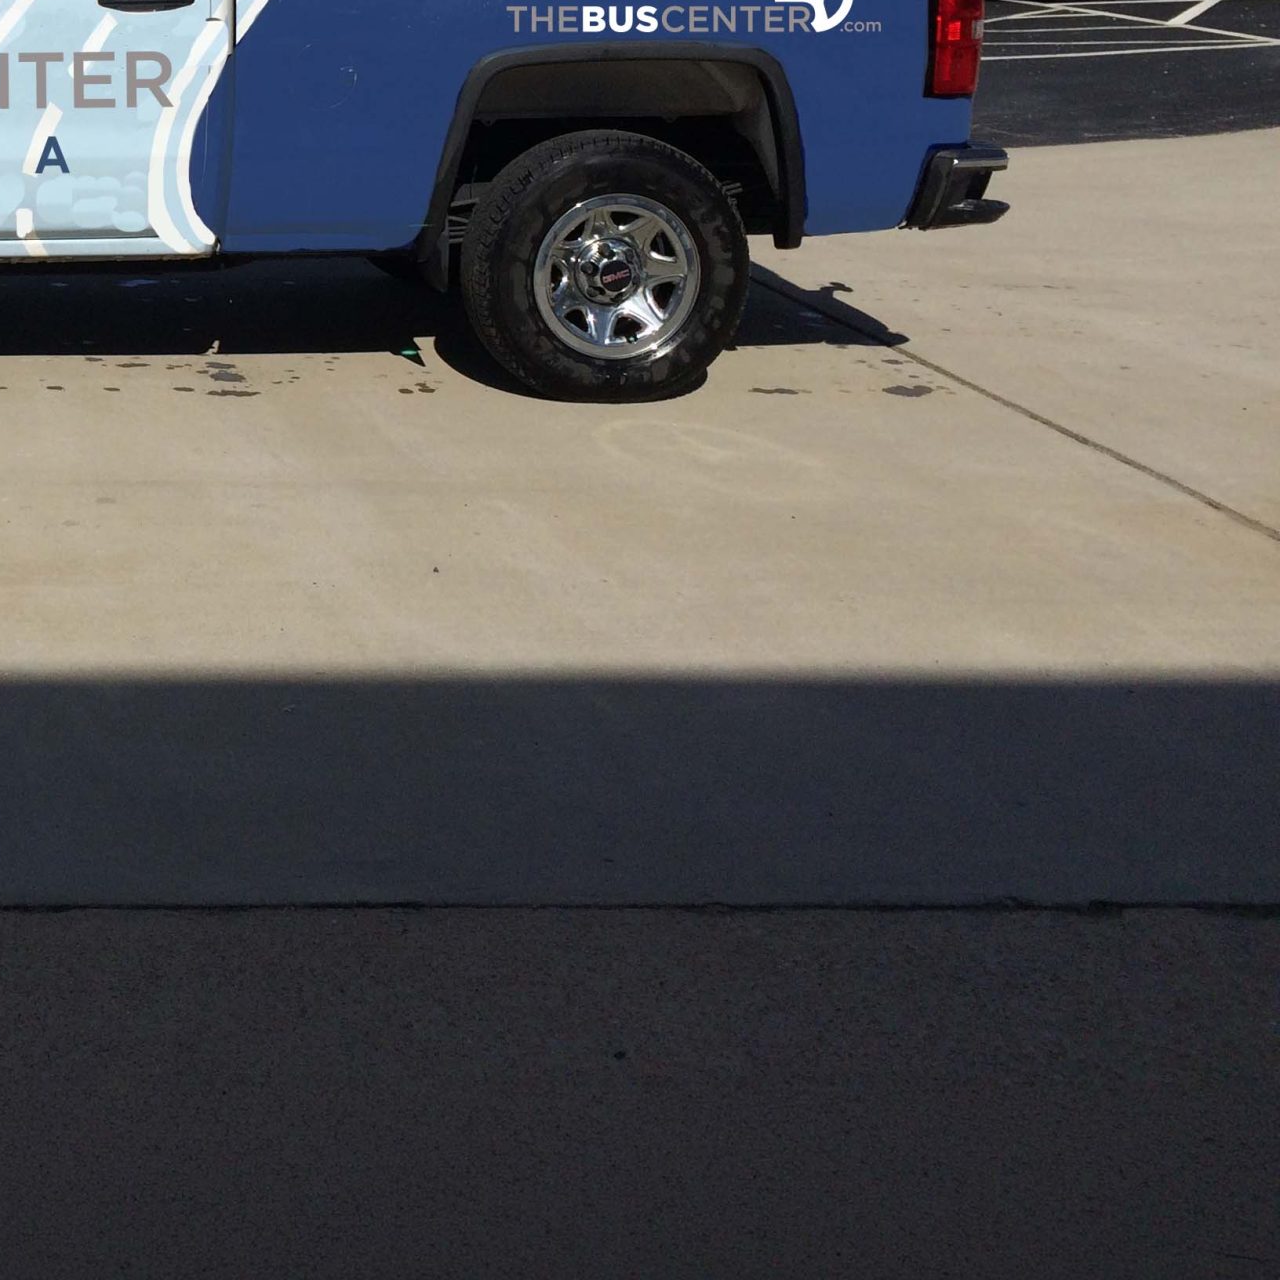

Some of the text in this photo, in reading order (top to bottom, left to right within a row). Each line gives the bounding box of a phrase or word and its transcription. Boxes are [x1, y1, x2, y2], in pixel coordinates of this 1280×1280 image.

[506, 6, 882, 33] THEBUSCENTER .com
[602, 269, 630, 284] GMC
